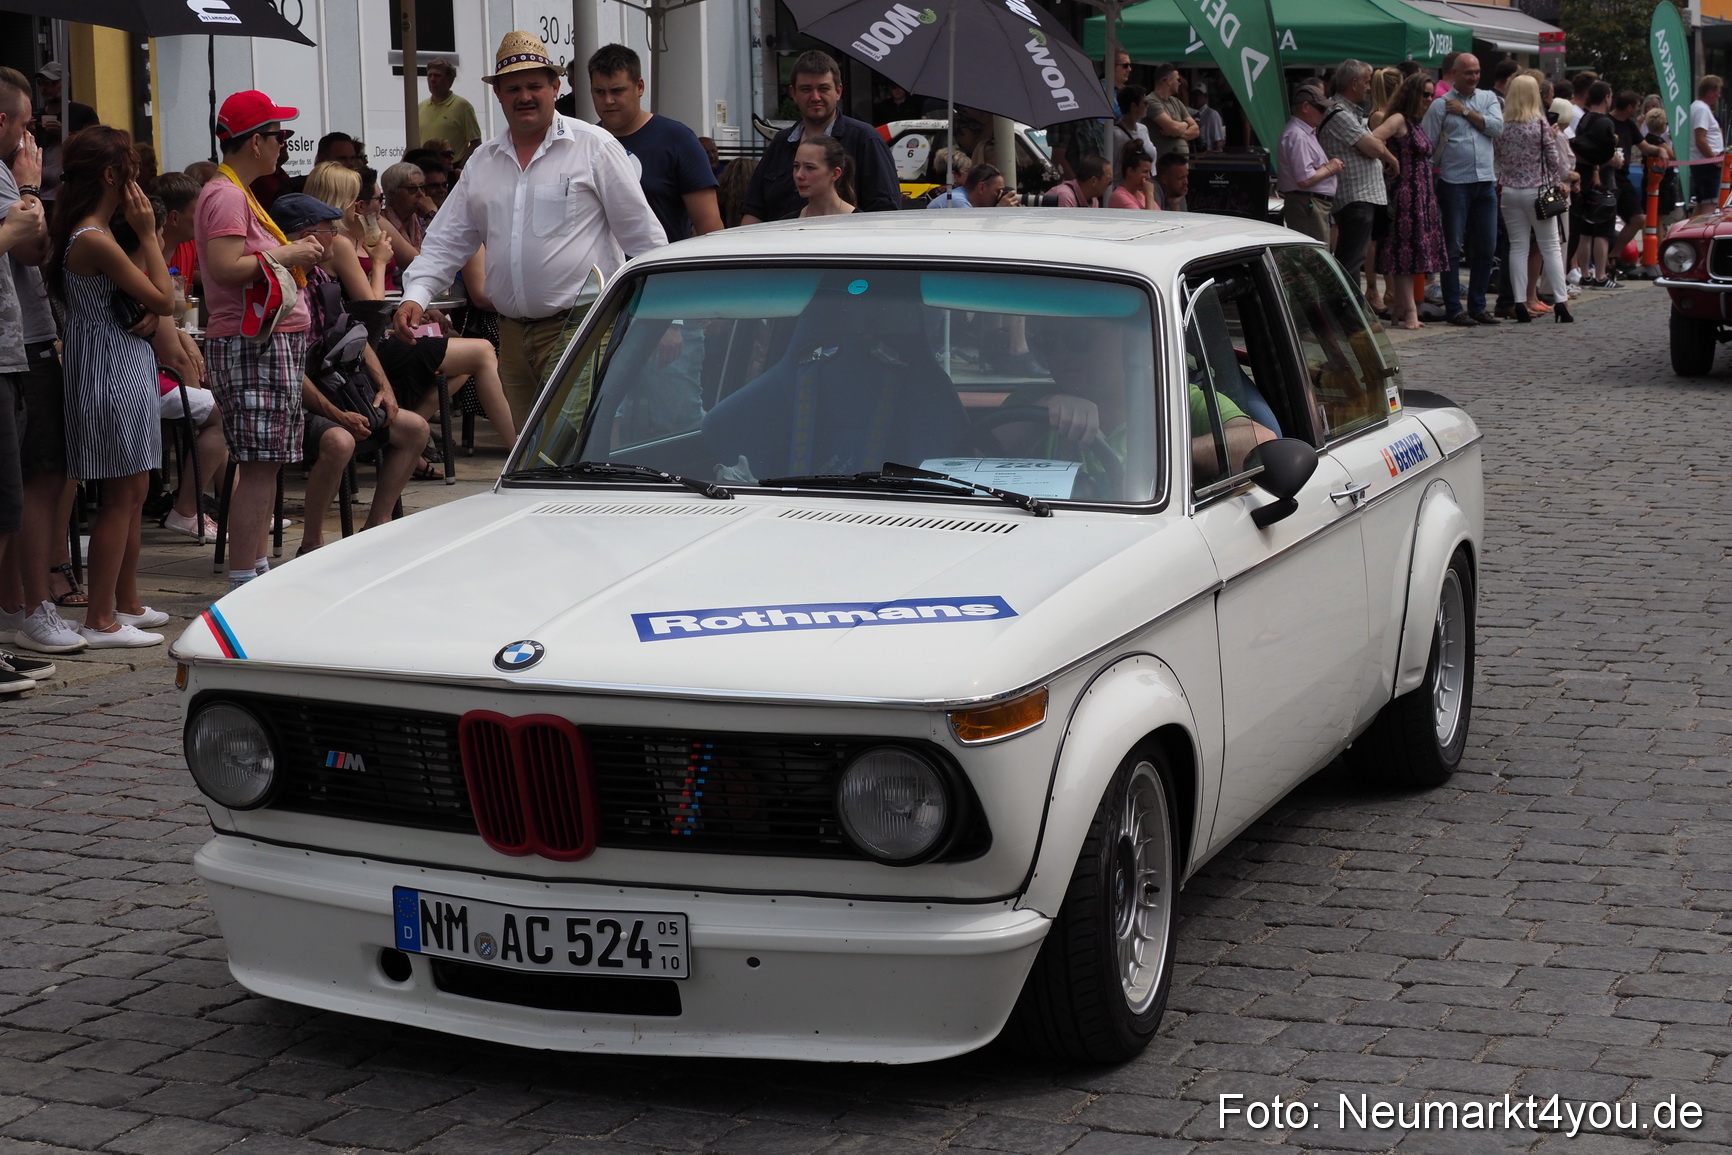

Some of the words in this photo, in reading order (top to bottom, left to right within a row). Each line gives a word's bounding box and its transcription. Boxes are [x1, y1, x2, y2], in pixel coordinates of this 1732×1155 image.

[539, 16, 559, 44] 30
[1435, 33, 1453, 55] DEKRA
[287, 136, 314, 152] ssler
[389, 146, 405, 157] schö
[907, 149, 914, 158] 6
[1389, 432, 1429, 473] BERNER
[649, 603, 1001, 635] Rothmans
[404, 926, 412, 939] D
[420, 898, 469, 953] NM
[501, 913, 553, 964] AC
[566, 917, 653, 969] 524
[658, 921, 678, 935] 05
[660, 955, 680, 970] 10
